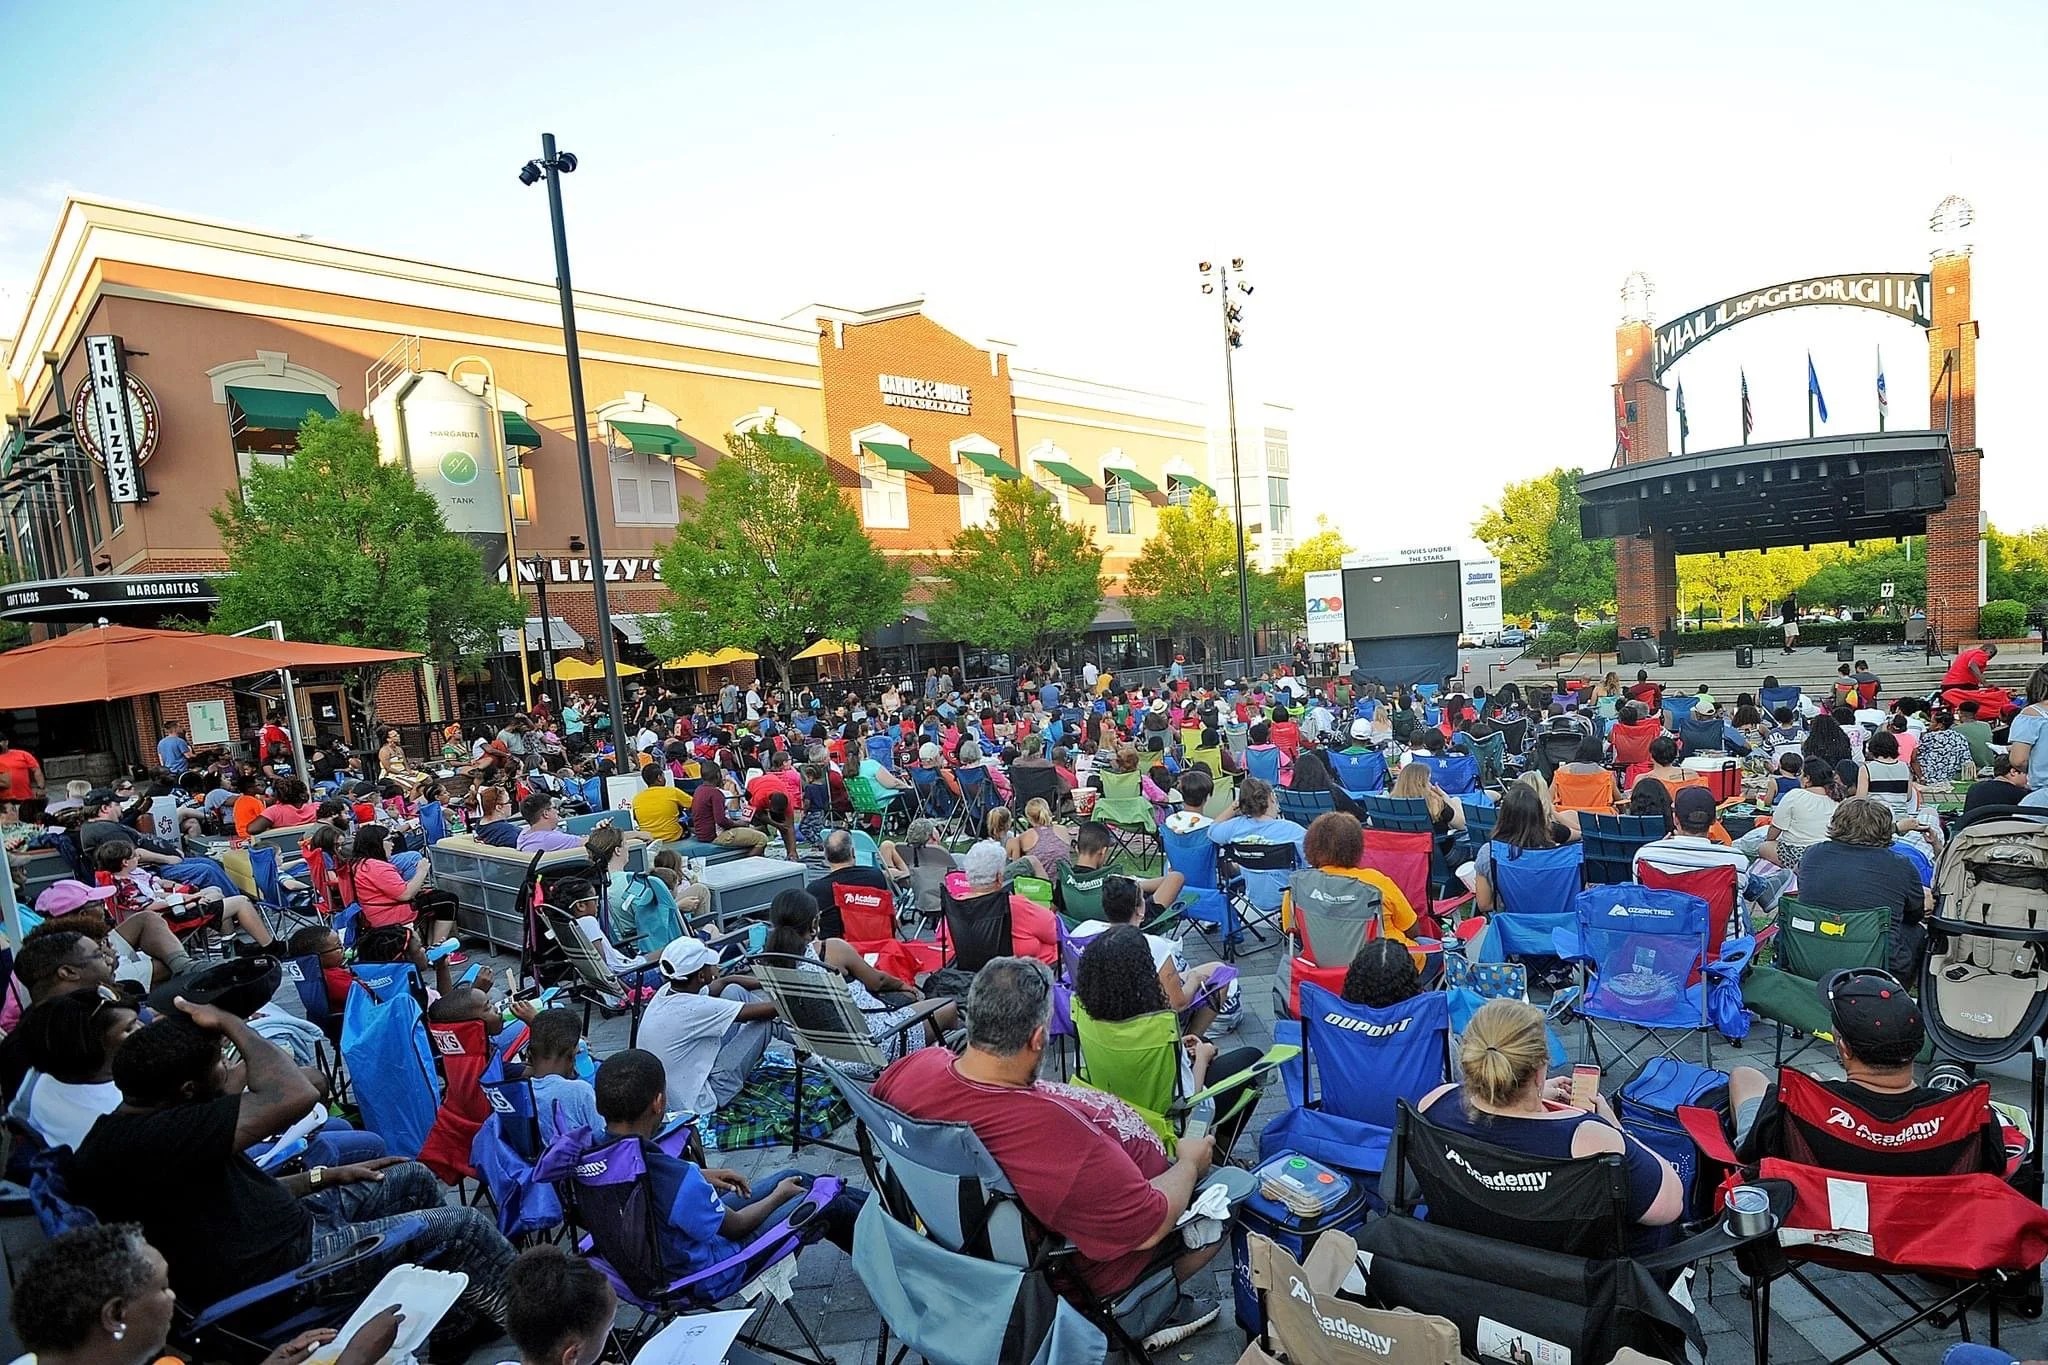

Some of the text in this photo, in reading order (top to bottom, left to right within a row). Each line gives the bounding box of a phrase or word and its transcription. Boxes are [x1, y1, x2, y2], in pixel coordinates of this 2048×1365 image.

[94, 343, 114, 388] TIN
[884, 394, 971, 415] BOOKSELLERS
[429, 431, 480, 439] MARGARITA
[498, 559, 536, 582] IN
[1468, 572, 1493, 580] Subaru
[19, 591, 39, 603] TACOS
[126, 582, 199, 596] MARGARITAS
[1308, 613, 1343, 621] Gwinnett
[1324, 1013, 1412, 1037] DUPONT
[1857, 1116, 1941, 1143] Academy
